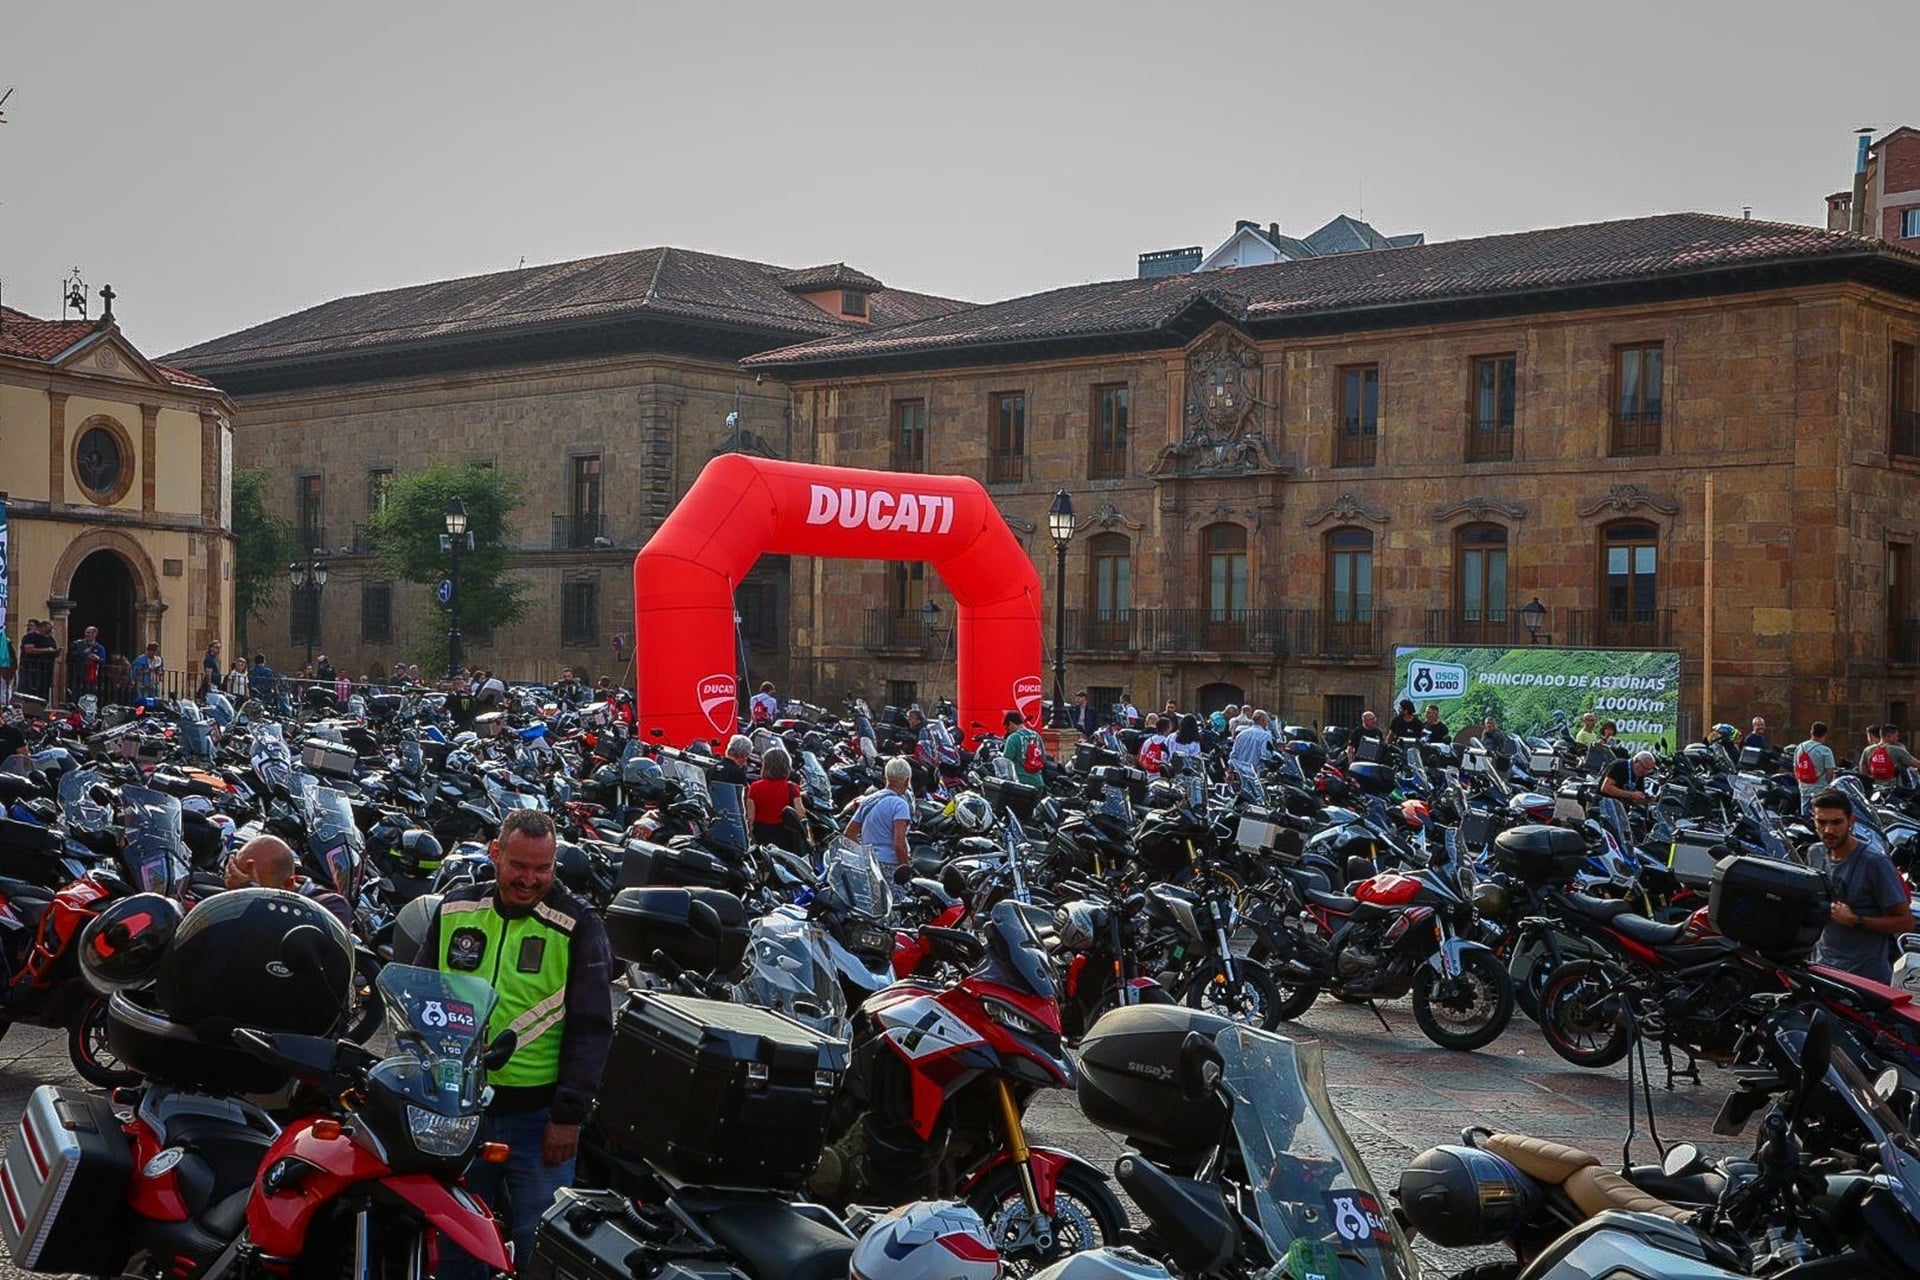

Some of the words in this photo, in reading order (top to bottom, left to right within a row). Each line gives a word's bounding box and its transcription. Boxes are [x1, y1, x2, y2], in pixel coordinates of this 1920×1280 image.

[806, 484, 954, 534] DUCATI
[1434, 671, 1460, 681] OSOS
[1478, 672, 1565, 688] PRINCIPADO
[1568, 675, 1589, 688] DE
[1590, 676, 1666, 691] ASTURIAS
[1434, 681, 1460, 690] 1000
[1594, 696, 1665, 712] 1000Km
[1607, 718, 1664, 734] 00Km
[448, 1012, 474, 1027] 642
